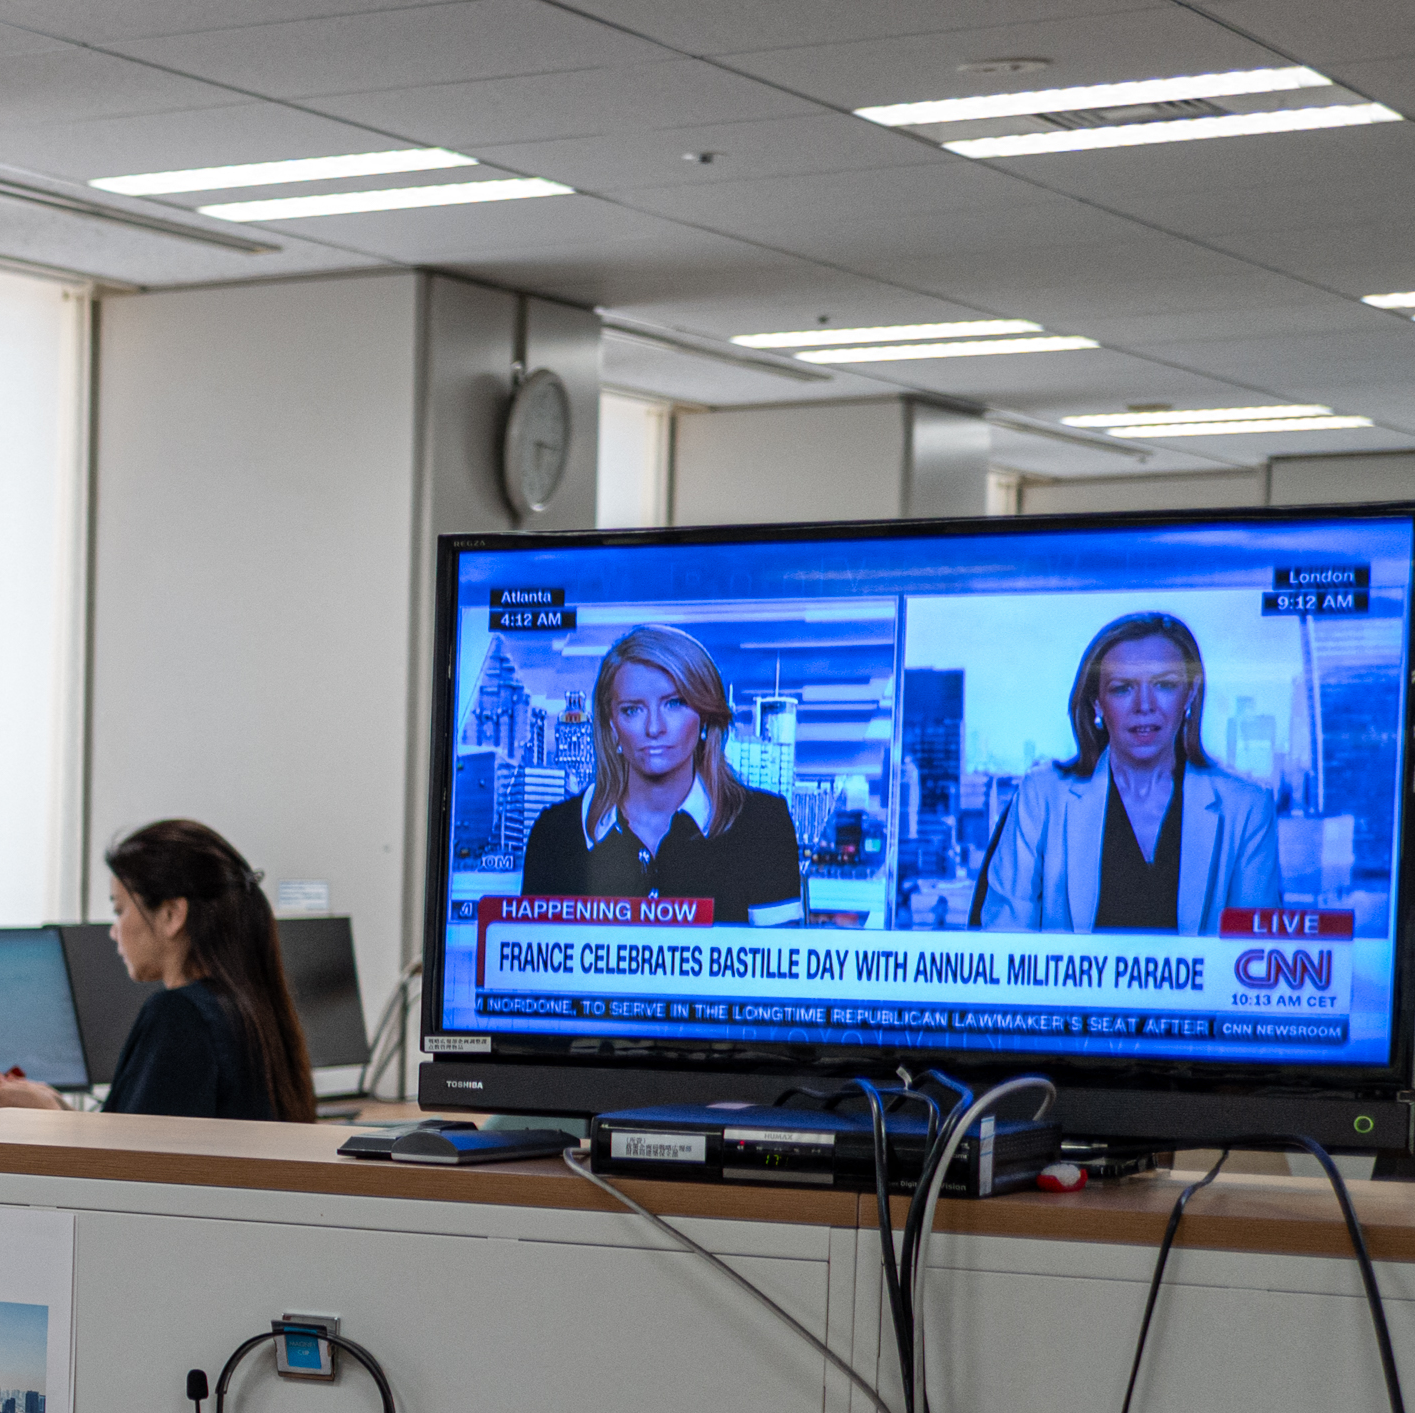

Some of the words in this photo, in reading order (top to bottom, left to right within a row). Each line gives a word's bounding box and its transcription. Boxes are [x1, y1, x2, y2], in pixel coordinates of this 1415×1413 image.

[1289, 570, 1353, 583] London
[501, 591, 551, 603] Atlanta
[1278, 596, 1316, 610] 9:12
[1323, 595, 1352, 608] AM
[501, 613, 532, 626] 4:12
[537, 613, 561, 626] AM
[502, 900, 631, 922] HAPPENING
[640, 902, 697, 922] NOW
[1253, 914, 1319, 933] LIVE
[500, 941, 574, 974] FRANCE
[580, 943, 702, 977] CELEBRATES
[709, 946, 799, 980] BASTILLE
[806, 949, 848, 981] DAY
[856, 951, 908, 982] WITH
[914, 951, 1000, 985] ANNUAL
[1007, 954, 1107, 989] MILITARY
[1115, 956, 1204, 991] PARADE
[1234, 949, 1332, 991] CNN
[1231, 993, 1271, 1006] 10:13
[1277, 995, 1301, 1007] AM
[1307, 996, 1337, 1008] CET
[582, 1000, 605, 1015] TO
[610, 1002, 665, 1017] SERVE
[671, 1003, 689, 1017] IN
[693, 1004, 728, 1019] THE
[733, 1005, 825, 1023] LONGTIME
[830, 1008, 948, 1026] REPUBLICAN
[1090, 1017, 1137, 1032] SEAT
[1142, 1018, 1209, 1036] AFTER
[1223, 1023, 1251, 1035] CNN
[1257, 1024, 1341, 1036] NEWSROOM
[445, 1080, 483, 1090] TOSHIBA
